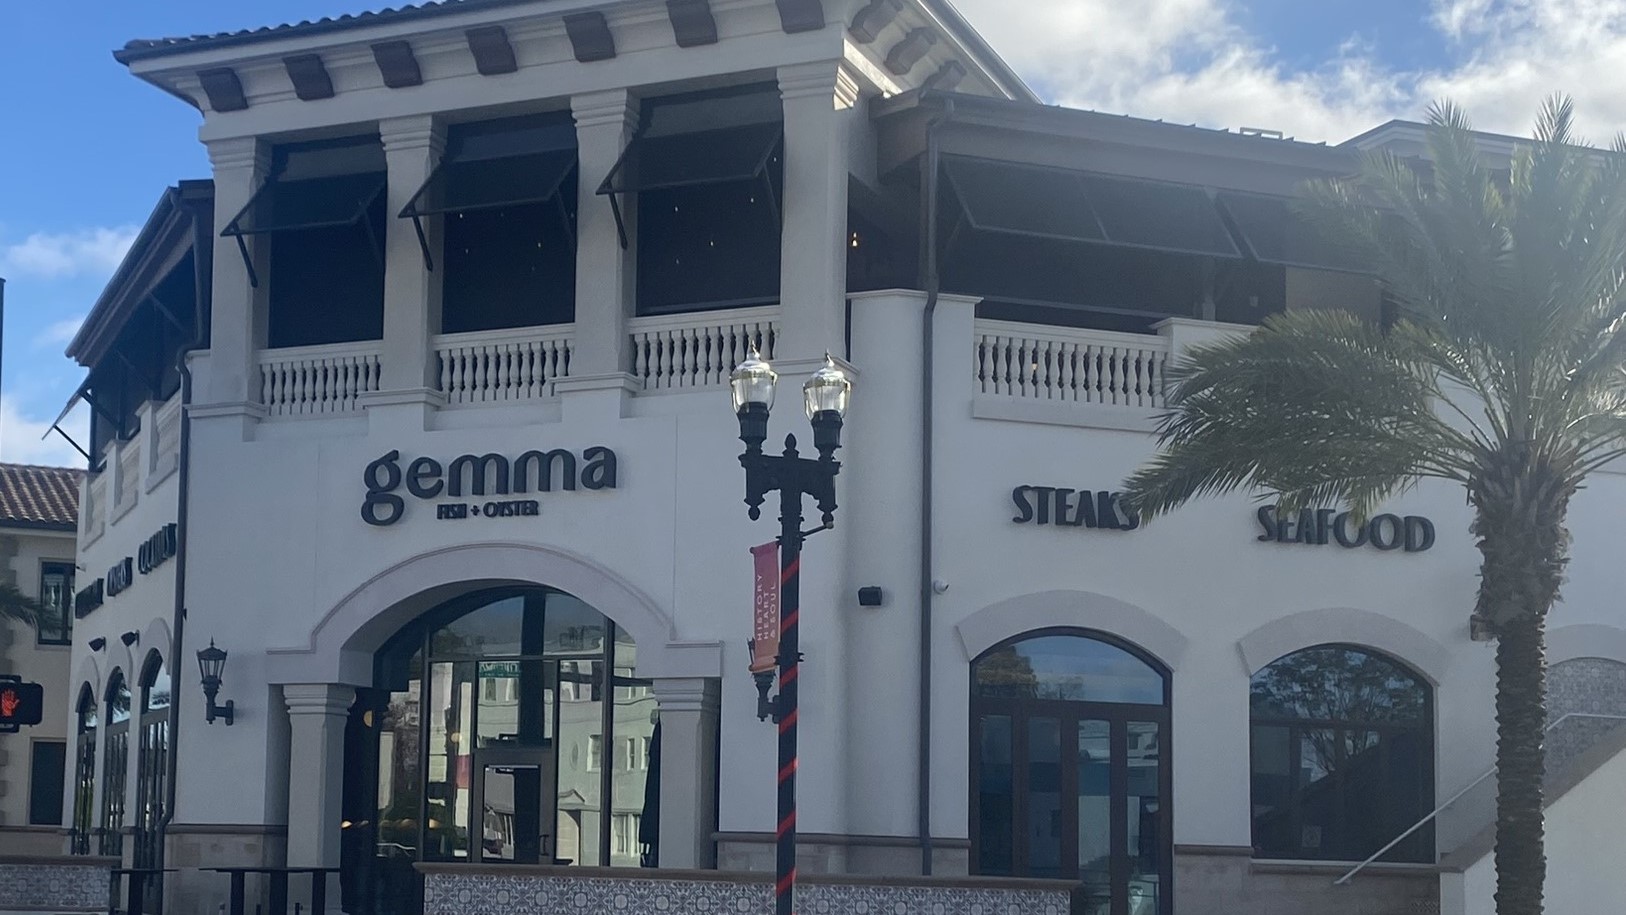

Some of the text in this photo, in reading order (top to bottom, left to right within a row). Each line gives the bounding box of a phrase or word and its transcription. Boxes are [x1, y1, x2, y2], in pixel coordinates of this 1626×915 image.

[361, 446, 617, 526] gemma
[437, 503, 467, 520] FISH
[483, 500, 539, 517] OYSTER
[1257, 504, 1435, 552] SEAFOOD
